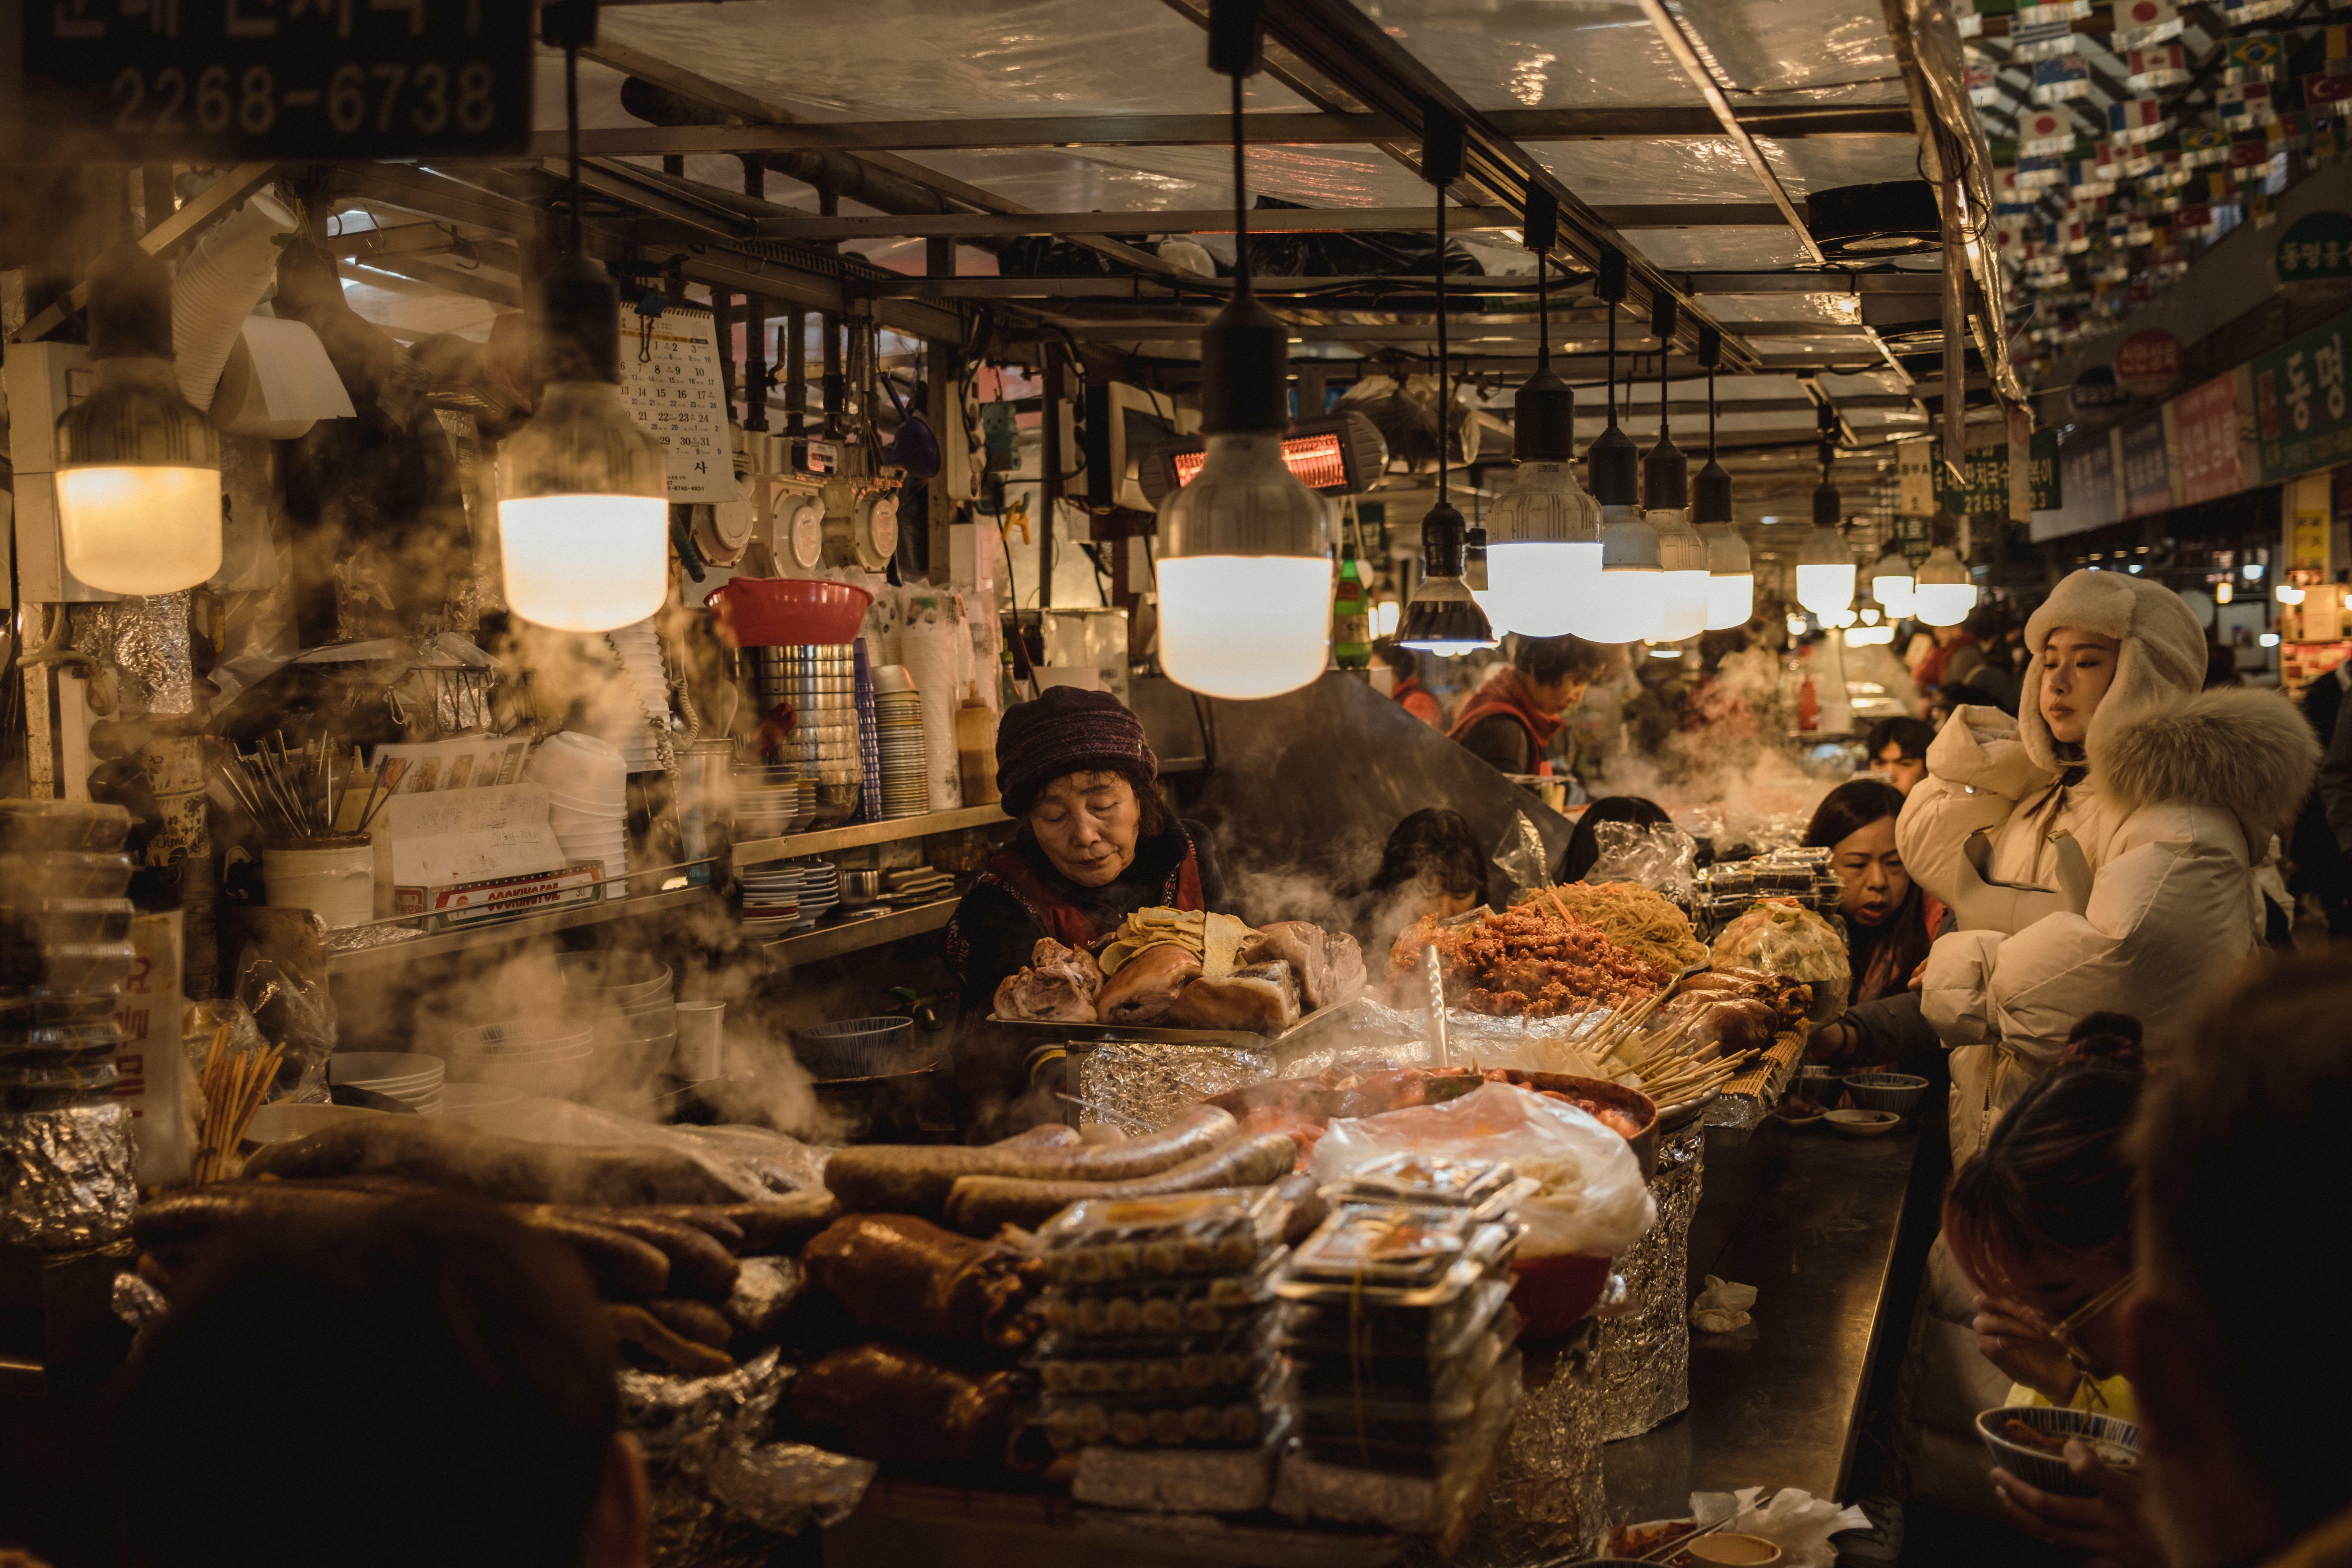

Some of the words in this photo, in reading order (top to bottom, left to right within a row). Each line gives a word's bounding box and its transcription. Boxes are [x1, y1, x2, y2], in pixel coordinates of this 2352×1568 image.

[113, 62, 497, 135] 2268-6738
[654, 341, 658, 350] 1
[672, 343, 678, 351] 2
[691, 344, 697, 353] 3
[620, 361, 626, 371] 6
[638, 363, 642, 372] 7
[654, 365, 661, 374] 8
[675, 366, 681, 375] 9
[695, 367, 704, 376] 10
[2285, 331, 2346, 432] 동명
[621, 386, 629, 395] 13
[638, 387, 646, 396] 14
[656, 388, 667, 398] 15
[677, 390, 687, 399] 16
[697, 390, 706, 400] 17
[638, 411, 648, 420] 21
[658, 412, 669, 421] 22
[679, 413, 689, 422] 23
[698, 414, 709, 423] 24
[660, 436, 670, 445] 29
[680, 437, 691, 446] 30
[700, 437, 710, 446] 31
[694, 461, 708, 474] 사
